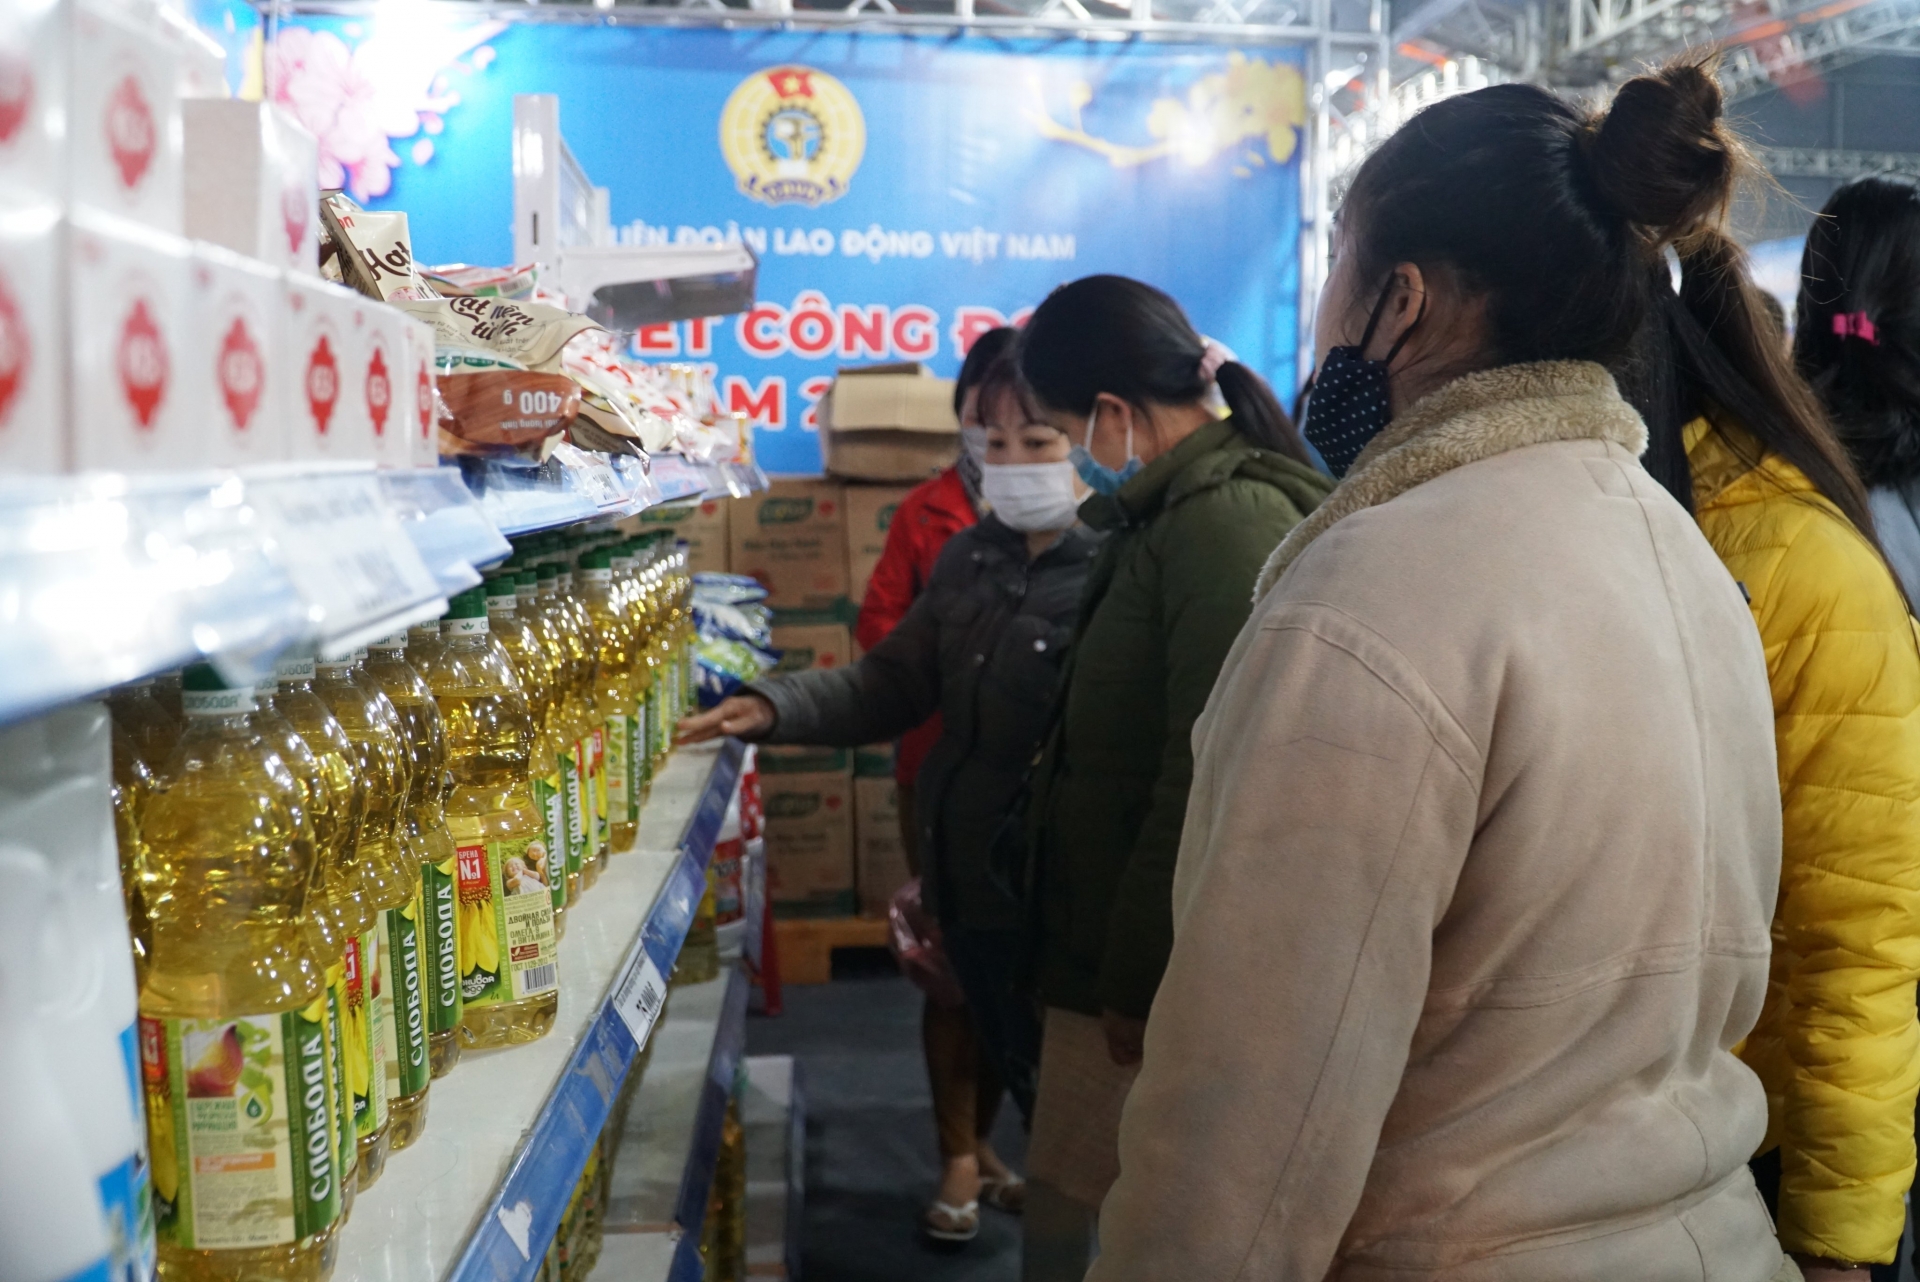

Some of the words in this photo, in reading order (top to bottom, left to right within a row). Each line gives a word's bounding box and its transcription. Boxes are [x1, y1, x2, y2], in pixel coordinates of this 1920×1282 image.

[773, 227, 835, 256] LAO
[838, 223, 934, 265] ĐỘNG
[939, 225, 1000, 265] VIỆT
[1005, 233, 1076, 261] NAM
[739, 292, 936, 355] CÔNG
[503, 389, 513, 405] g
[519, 391, 562, 414] 400
[459, 850, 478, 859] БРЕНД
